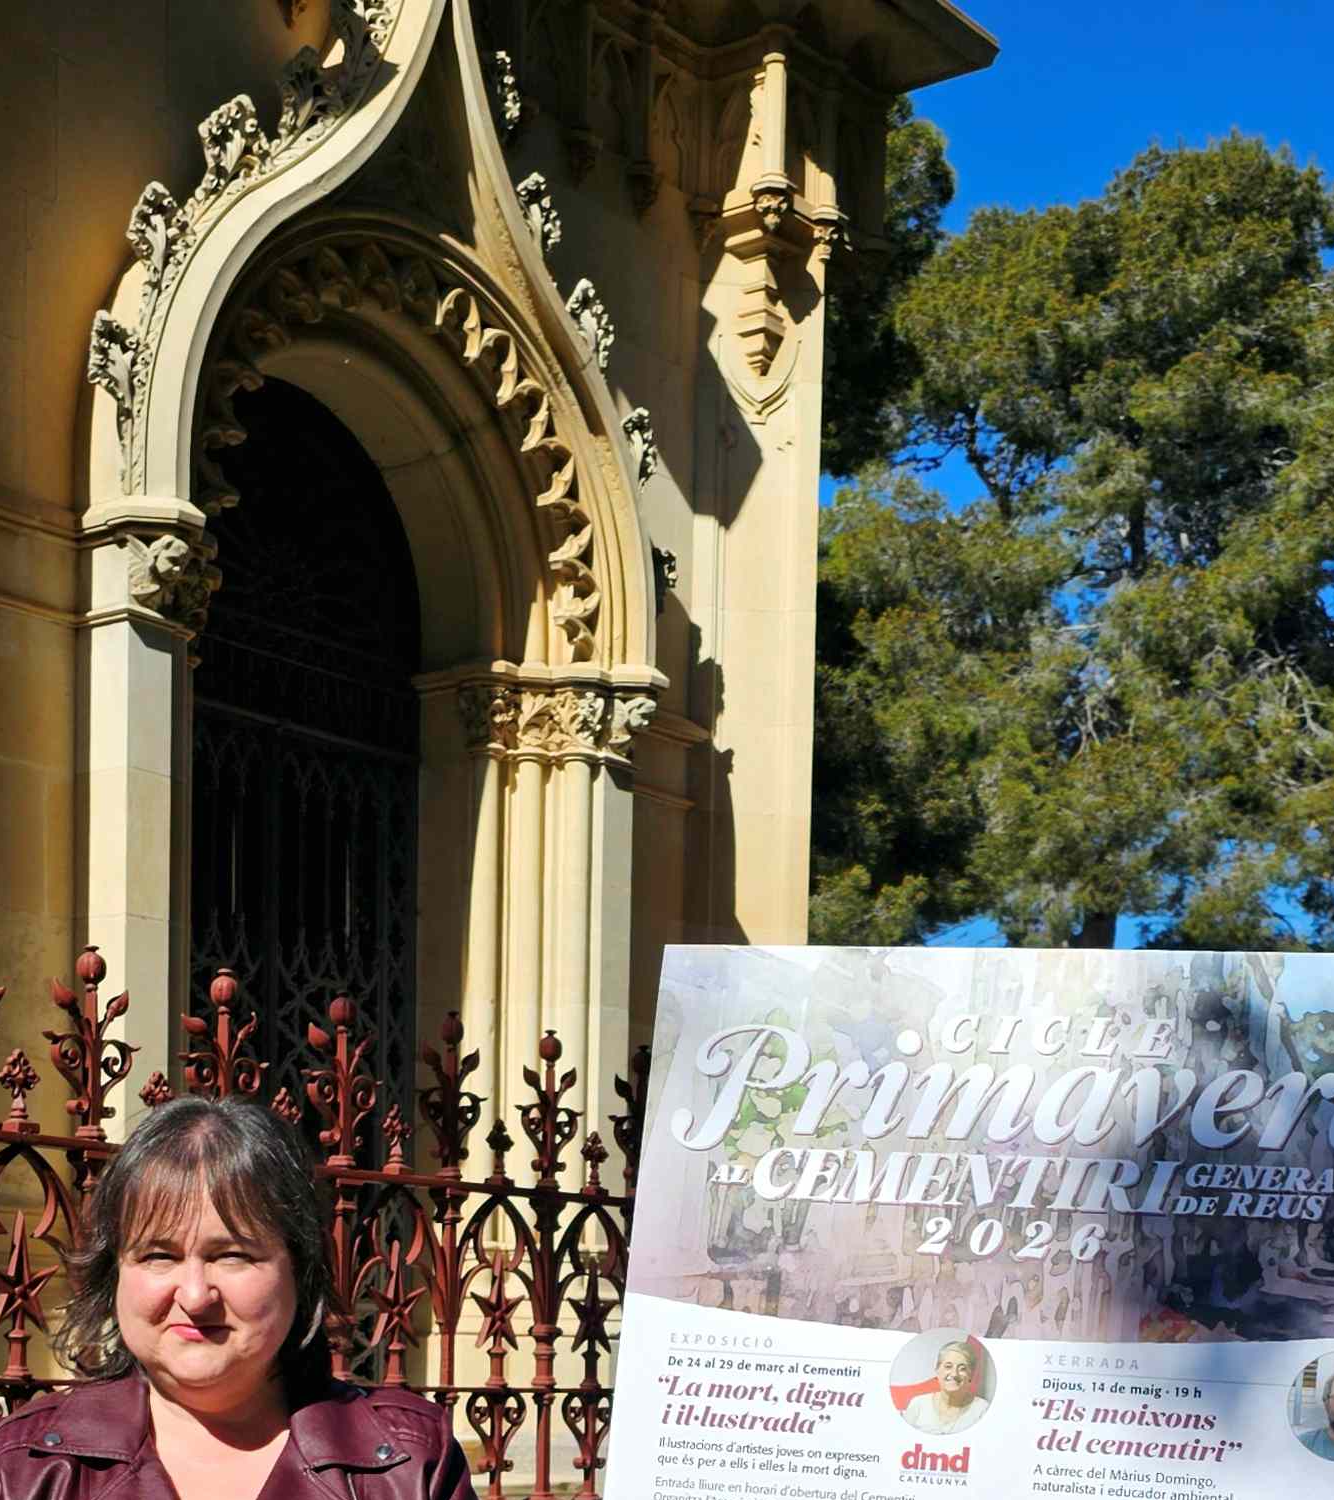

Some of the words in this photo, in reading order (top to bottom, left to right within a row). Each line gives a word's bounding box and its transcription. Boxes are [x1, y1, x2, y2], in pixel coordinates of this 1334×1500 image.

[941, 1014, 1178, 1059] CICLE
[709, 1164, 751, 1185] AL
[752, 1147, 1187, 1217] CEMENTIRI
[1172, 1194, 1220, 1217] DE
[1223, 1193, 1328, 1221] REUS
[915, 1216, 1107, 1263] 2026
[670, 1332, 773, 1349] EXPOSICIÓ
[667, 1355, 684, 1367] De
[687, 1356, 701, 1368] 24
[704, 1357, 716, 1369] al
[719, 1358, 734, 1370] 29
[737, 1359, 752, 1371] de
[754, 1363, 785, 1375] març
[787, 1362, 799, 1374] al
[802, 1363, 861, 1378] Cementiri
[1043, 1353, 1140, 1371] XERRADA
[657, 1375, 703, 1397] “La
[705, 1383, 779, 1403] mort,
[785, 1382, 865, 1411] digna
[1091, 1381, 1105, 1393] 14
[1109, 1381, 1126, 1394] de
[1130, 1383, 1163, 1400] maig
[1175, 1386, 1190, 1398] 19
[661, 1403, 673, 1425] i
[675, 1404, 831, 1435] il·lustrada”
[1031, 1398, 1087, 1422] “Els
[1090, 1403, 1217, 1431] moixons
[901, 1442, 971, 1474] dmd
[1036, 1428, 1083, 1453] del
[1085, 1438, 1243, 1463] cementiri”
[898, 1474, 967, 1487] CATALUNYA
[1032, 1481, 1097, 1496] naturalista
[1107, 1484, 1167, 1500] educador
[1045, 1464, 1084, 1479] càrrec
[1086, 1466, 1107, 1480] del
[1109, 1469, 1151, 1484] Màrius
[1154, 1472, 1217, 1490] Domingo,
